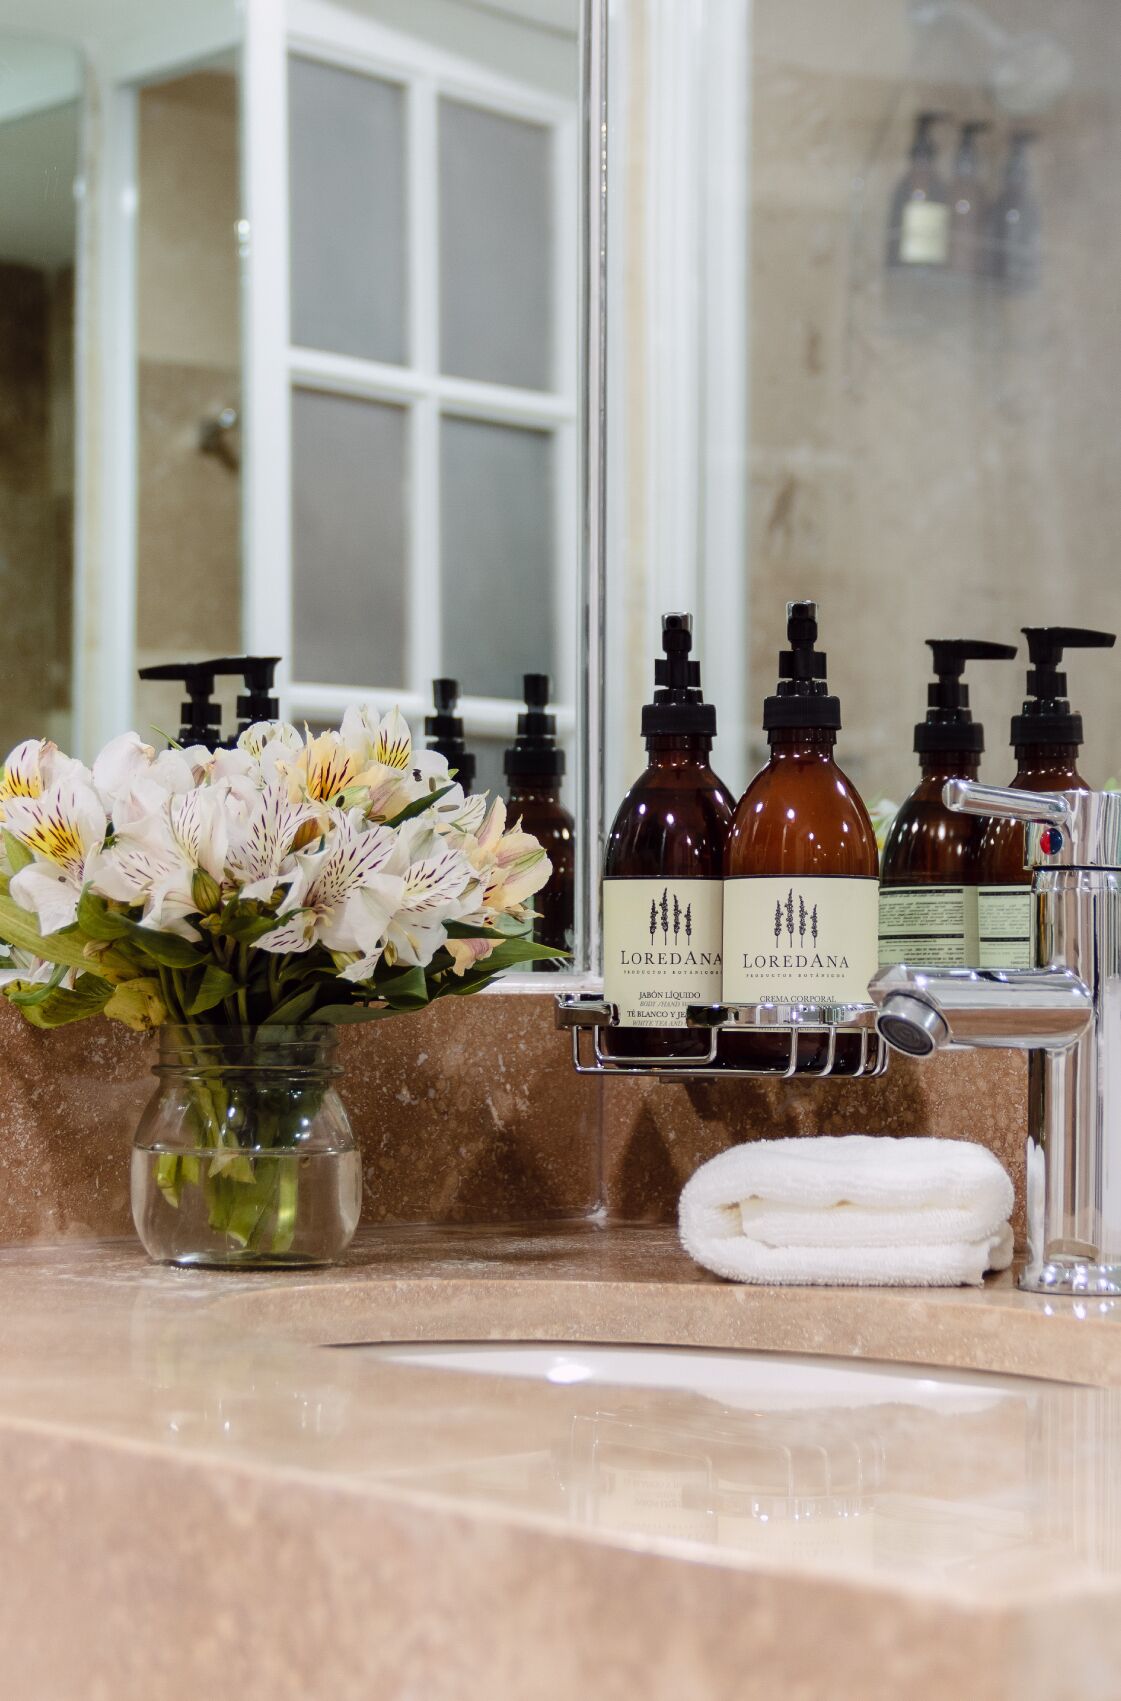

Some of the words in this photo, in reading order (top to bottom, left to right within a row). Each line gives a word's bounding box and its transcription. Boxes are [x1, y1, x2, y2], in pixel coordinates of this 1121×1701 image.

[621, 950, 723, 965] LOREDANA
[743, 953, 849, 968] LOREDANA
[639, 990, 663, 1000] JABÓN
[665, 990, 701, 1000] LÍQUIDO
[759, 995, 789, 1003] CREMA
[790, 995, 837, 1003] CORPORAL
[627, 1009, 636, 1018] TÉ
[637, 1010, 669, 1018] BLANCO
